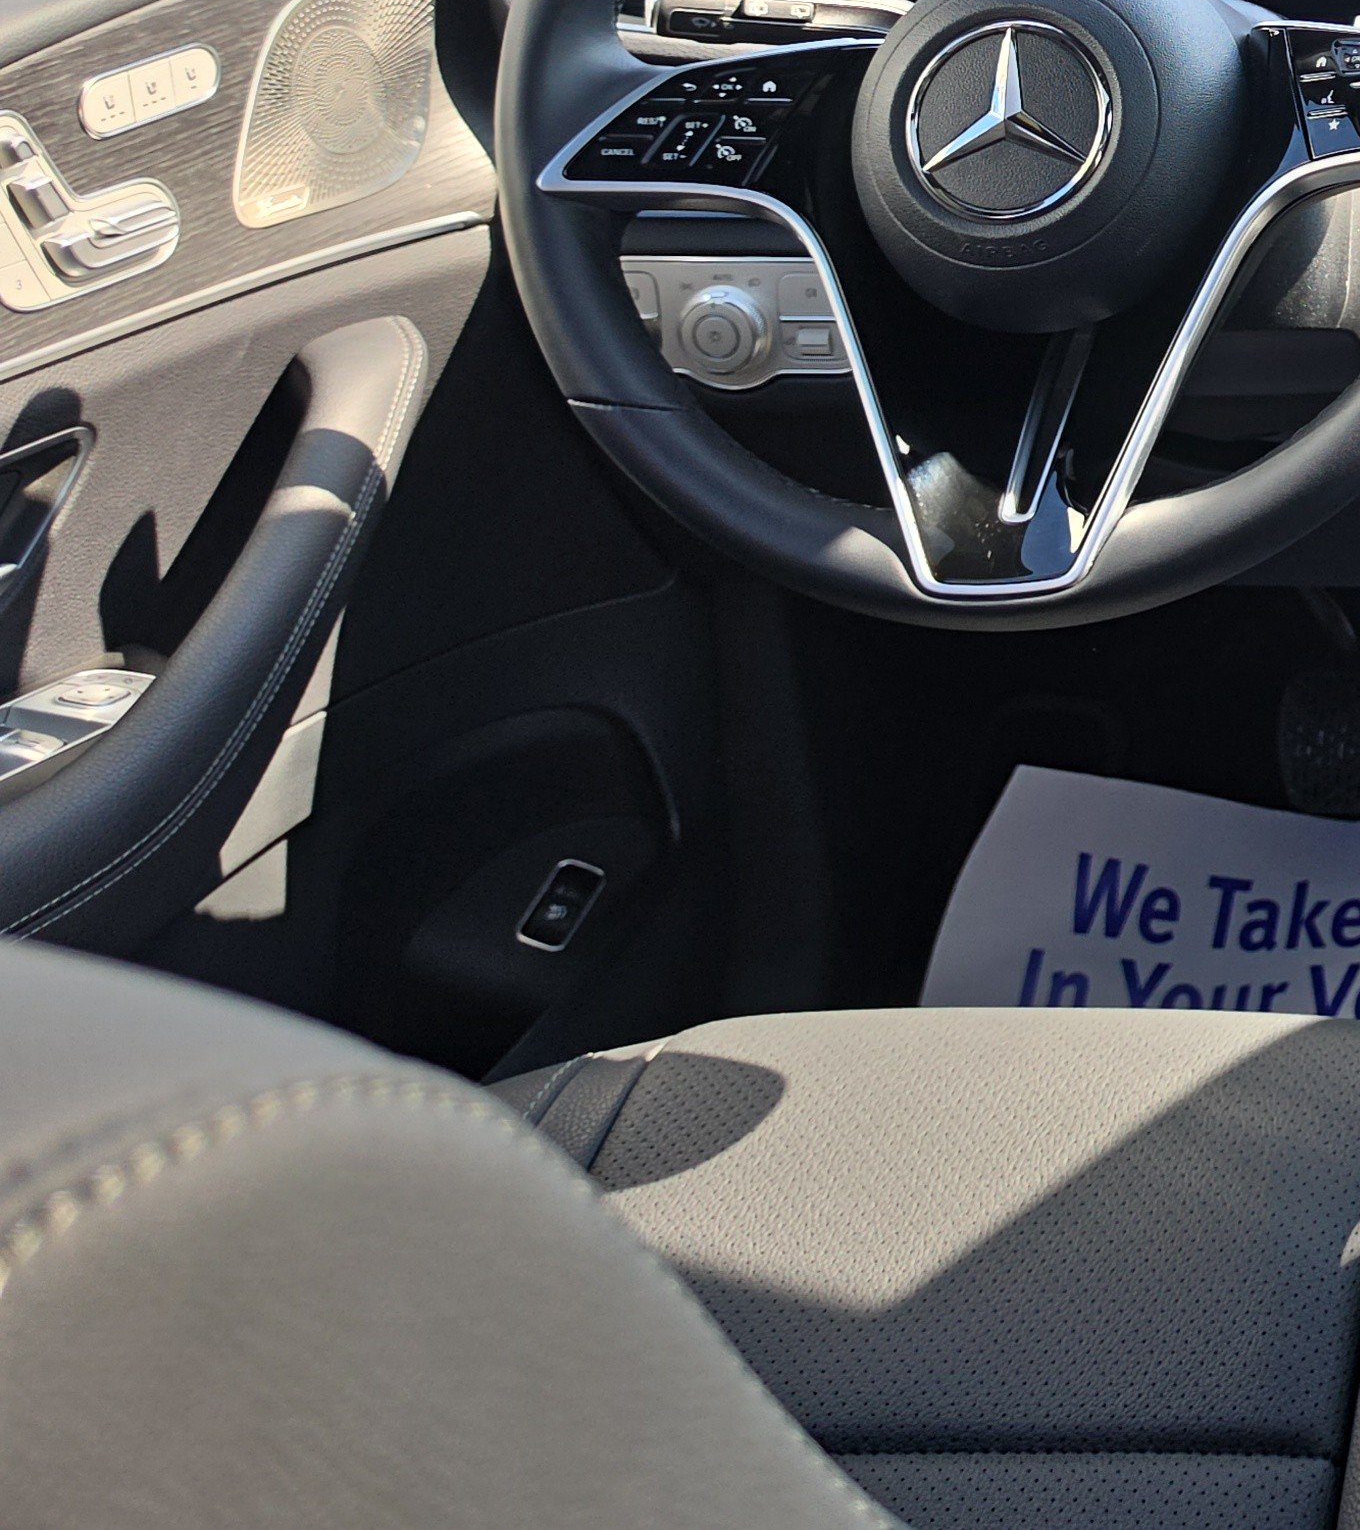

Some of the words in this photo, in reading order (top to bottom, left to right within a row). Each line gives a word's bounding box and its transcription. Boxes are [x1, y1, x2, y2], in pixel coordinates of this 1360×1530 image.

[601, 148, 635, 157] CANCEL
[1073, 851, 1182, 945] We
[1017, 949, 1090, 1008] In
[1121, 958, 1291, 1013] Your
